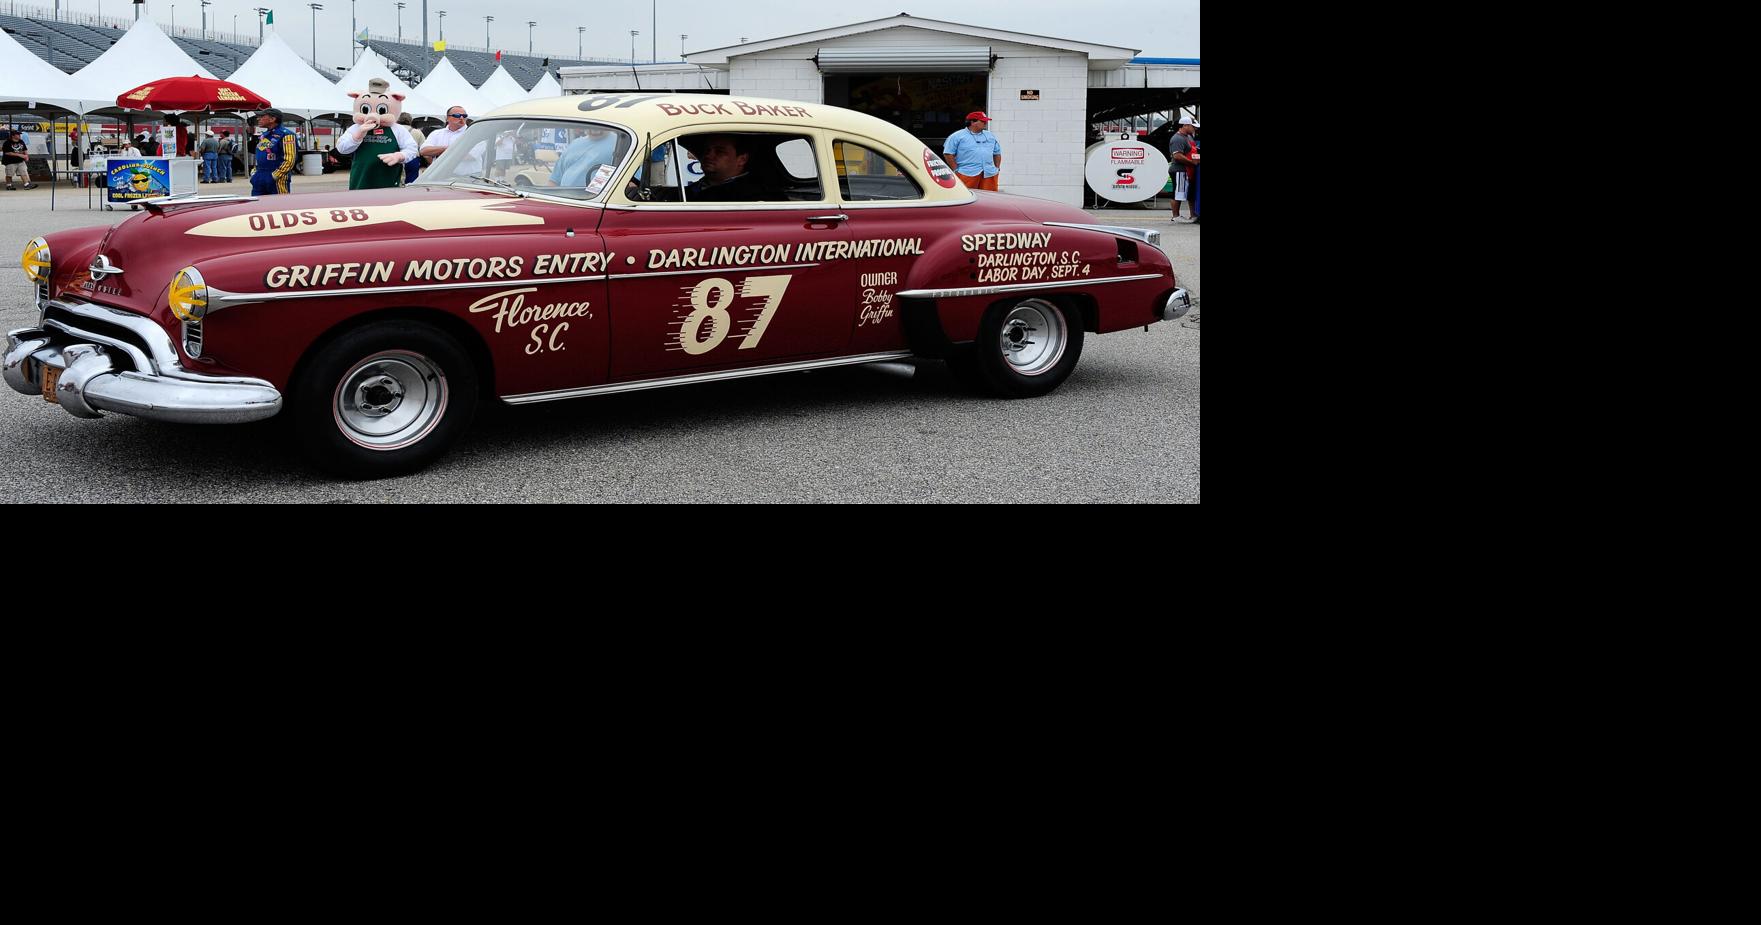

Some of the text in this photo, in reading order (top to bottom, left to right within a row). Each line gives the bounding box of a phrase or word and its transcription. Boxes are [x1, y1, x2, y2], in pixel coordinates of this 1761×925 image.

[656, 100, 813, 118] BUCK BAKER
[248, 208, 369, 231] OLDS 88
[266, 232, 1052, 288] GRIFFIN MOTORS ENTRY DARLINGTON INTERNATIONAL SPEEDWAY
[860, 271, 898, 288] OWNER
[978, 268, 1019, 283] LABOR
[1051, 265, 1080, 278] SEPT.
[1081, 263, 1091, 276] 4
[861, 288, 893, 305] Bobby
[469, 287, 593, 333] Florence,
[664, 274, 793, 355] 87
[858, 304, 894, 327] Griffin
[525, 322, 570, 355] S.C.
